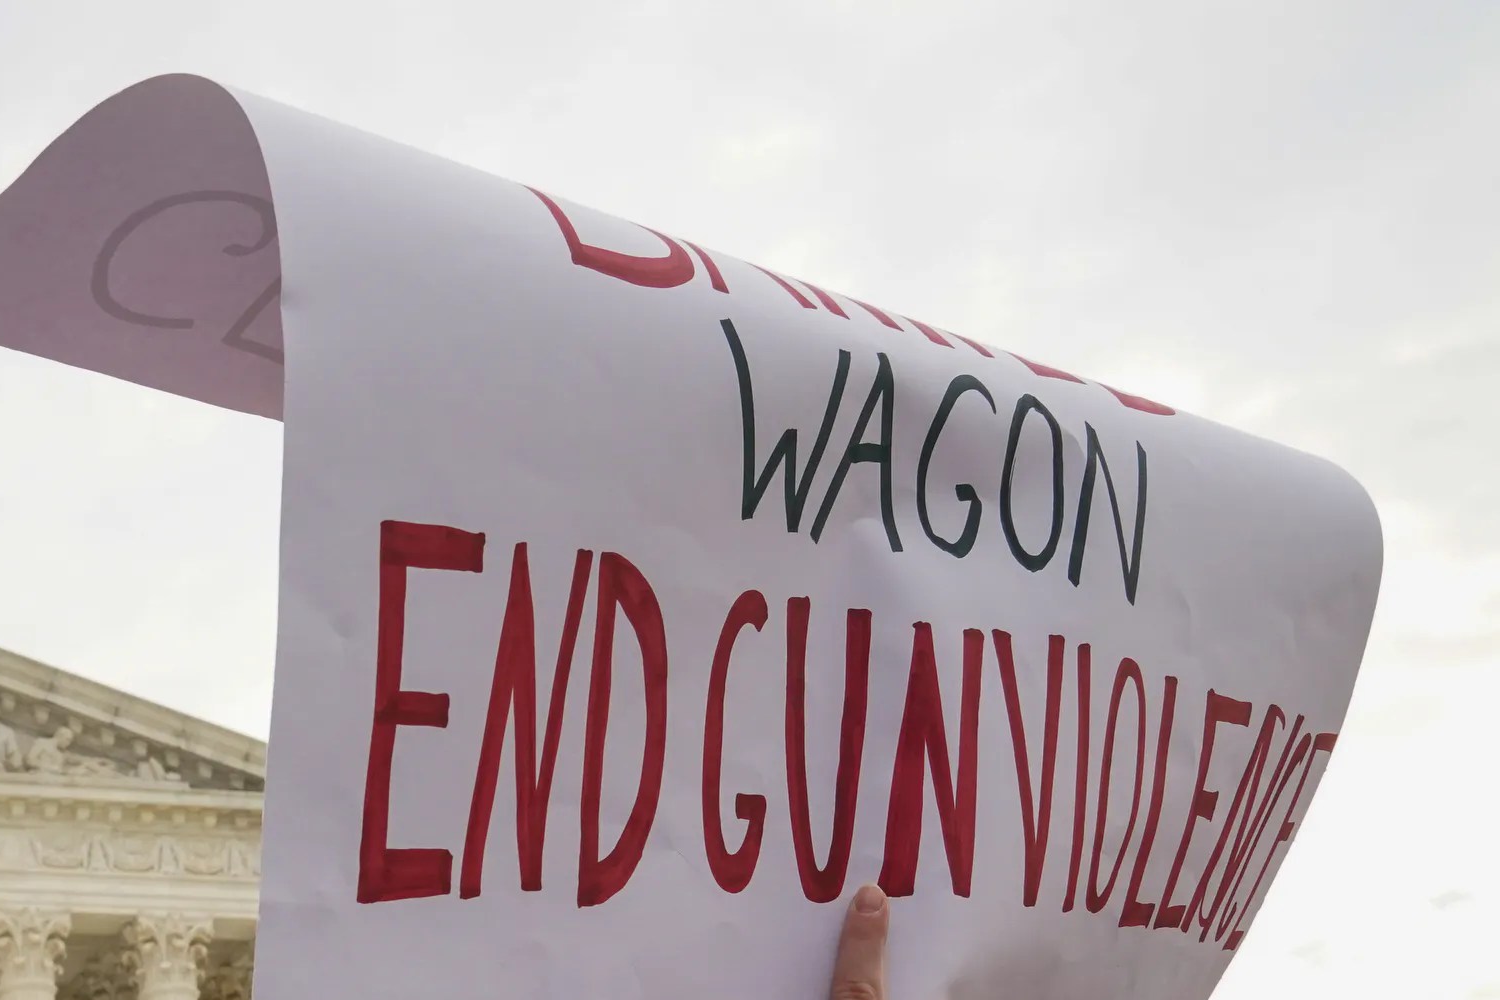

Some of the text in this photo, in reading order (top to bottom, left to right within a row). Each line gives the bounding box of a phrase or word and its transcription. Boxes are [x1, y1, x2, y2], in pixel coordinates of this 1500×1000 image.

[719, 317, 1147, 607] WAGON
[356, 519, 1340, 951] END GUN VIOLENCE
